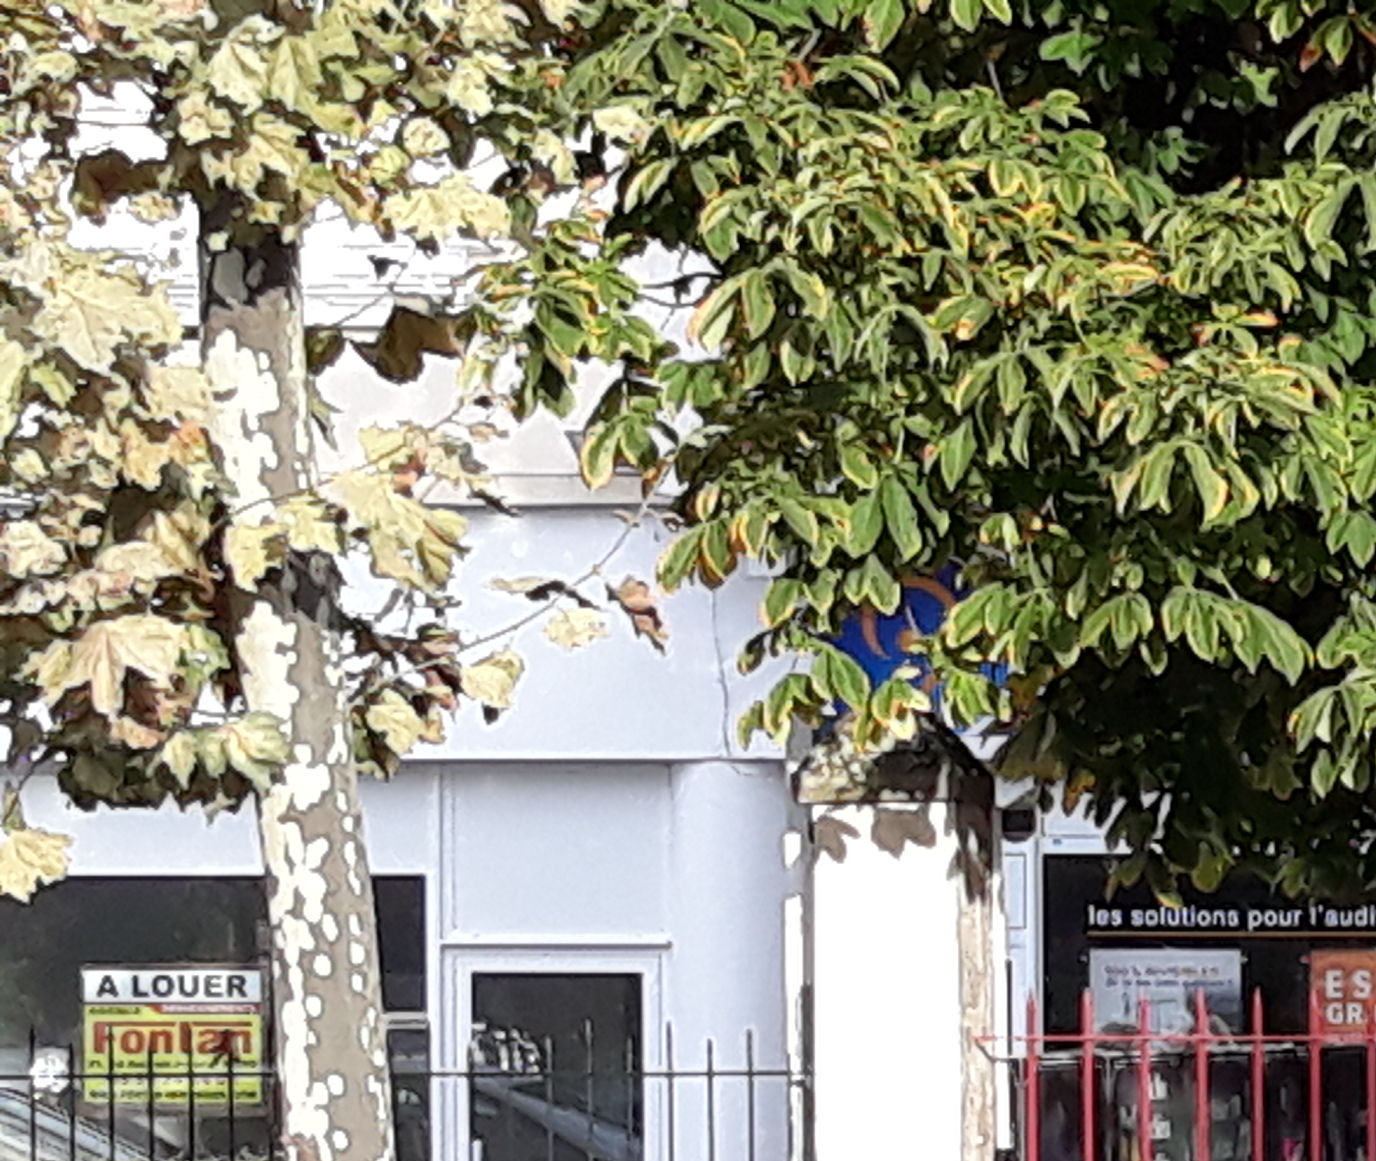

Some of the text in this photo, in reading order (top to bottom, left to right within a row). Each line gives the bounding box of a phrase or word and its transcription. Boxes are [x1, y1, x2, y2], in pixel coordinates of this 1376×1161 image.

[1088, 904, 1123, 926] les
[1130, 904, 1240, 927] solutions
[1247, 907, 1302, 931] pour
[96, 974, 248, 998] A LOUER
